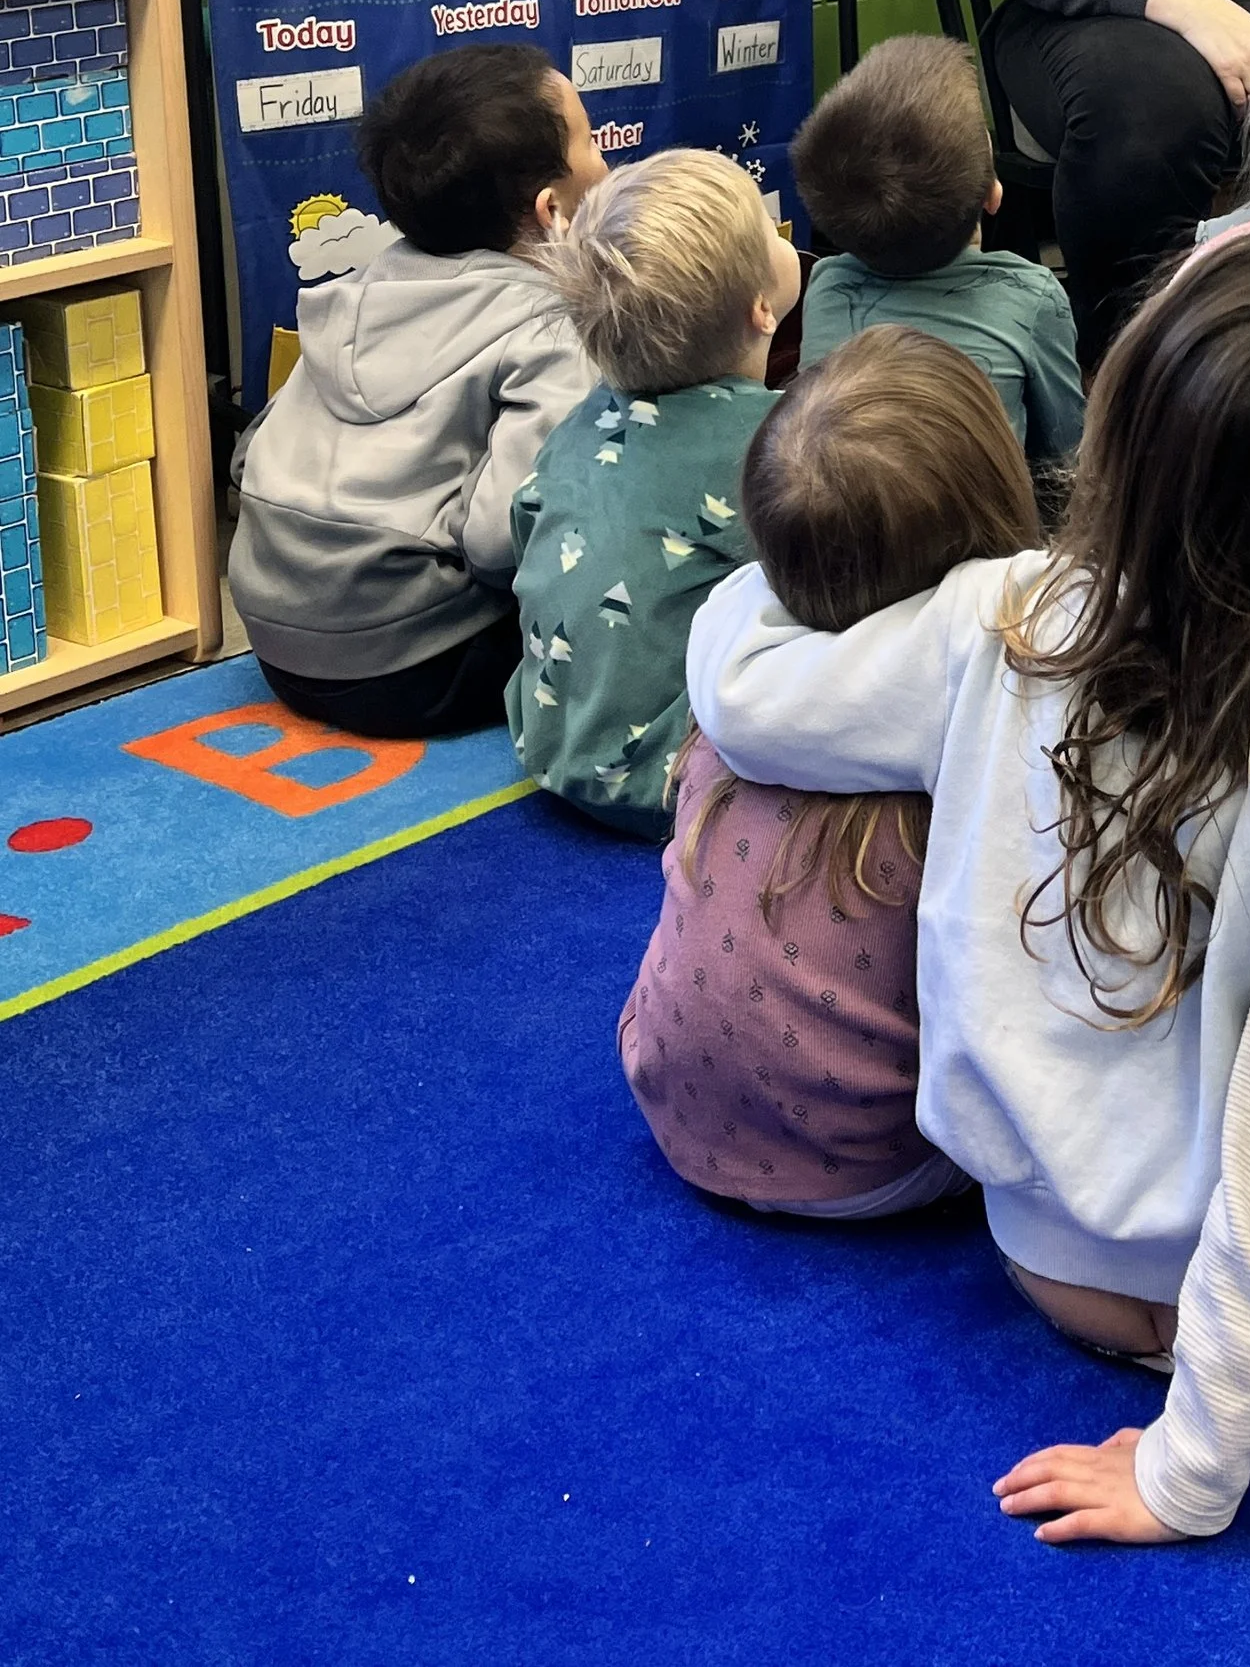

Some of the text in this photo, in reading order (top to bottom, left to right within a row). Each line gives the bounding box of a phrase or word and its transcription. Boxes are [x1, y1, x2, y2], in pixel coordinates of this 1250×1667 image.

[260, 20, 354, 49] Today
[721, 33, 776, 68] Winter
[575, 48, 654, 88] Saturday
[259, 80, 338, 121] Friday
[591, 124, 642, 150] ther
[120, 701, 428, 818] B
